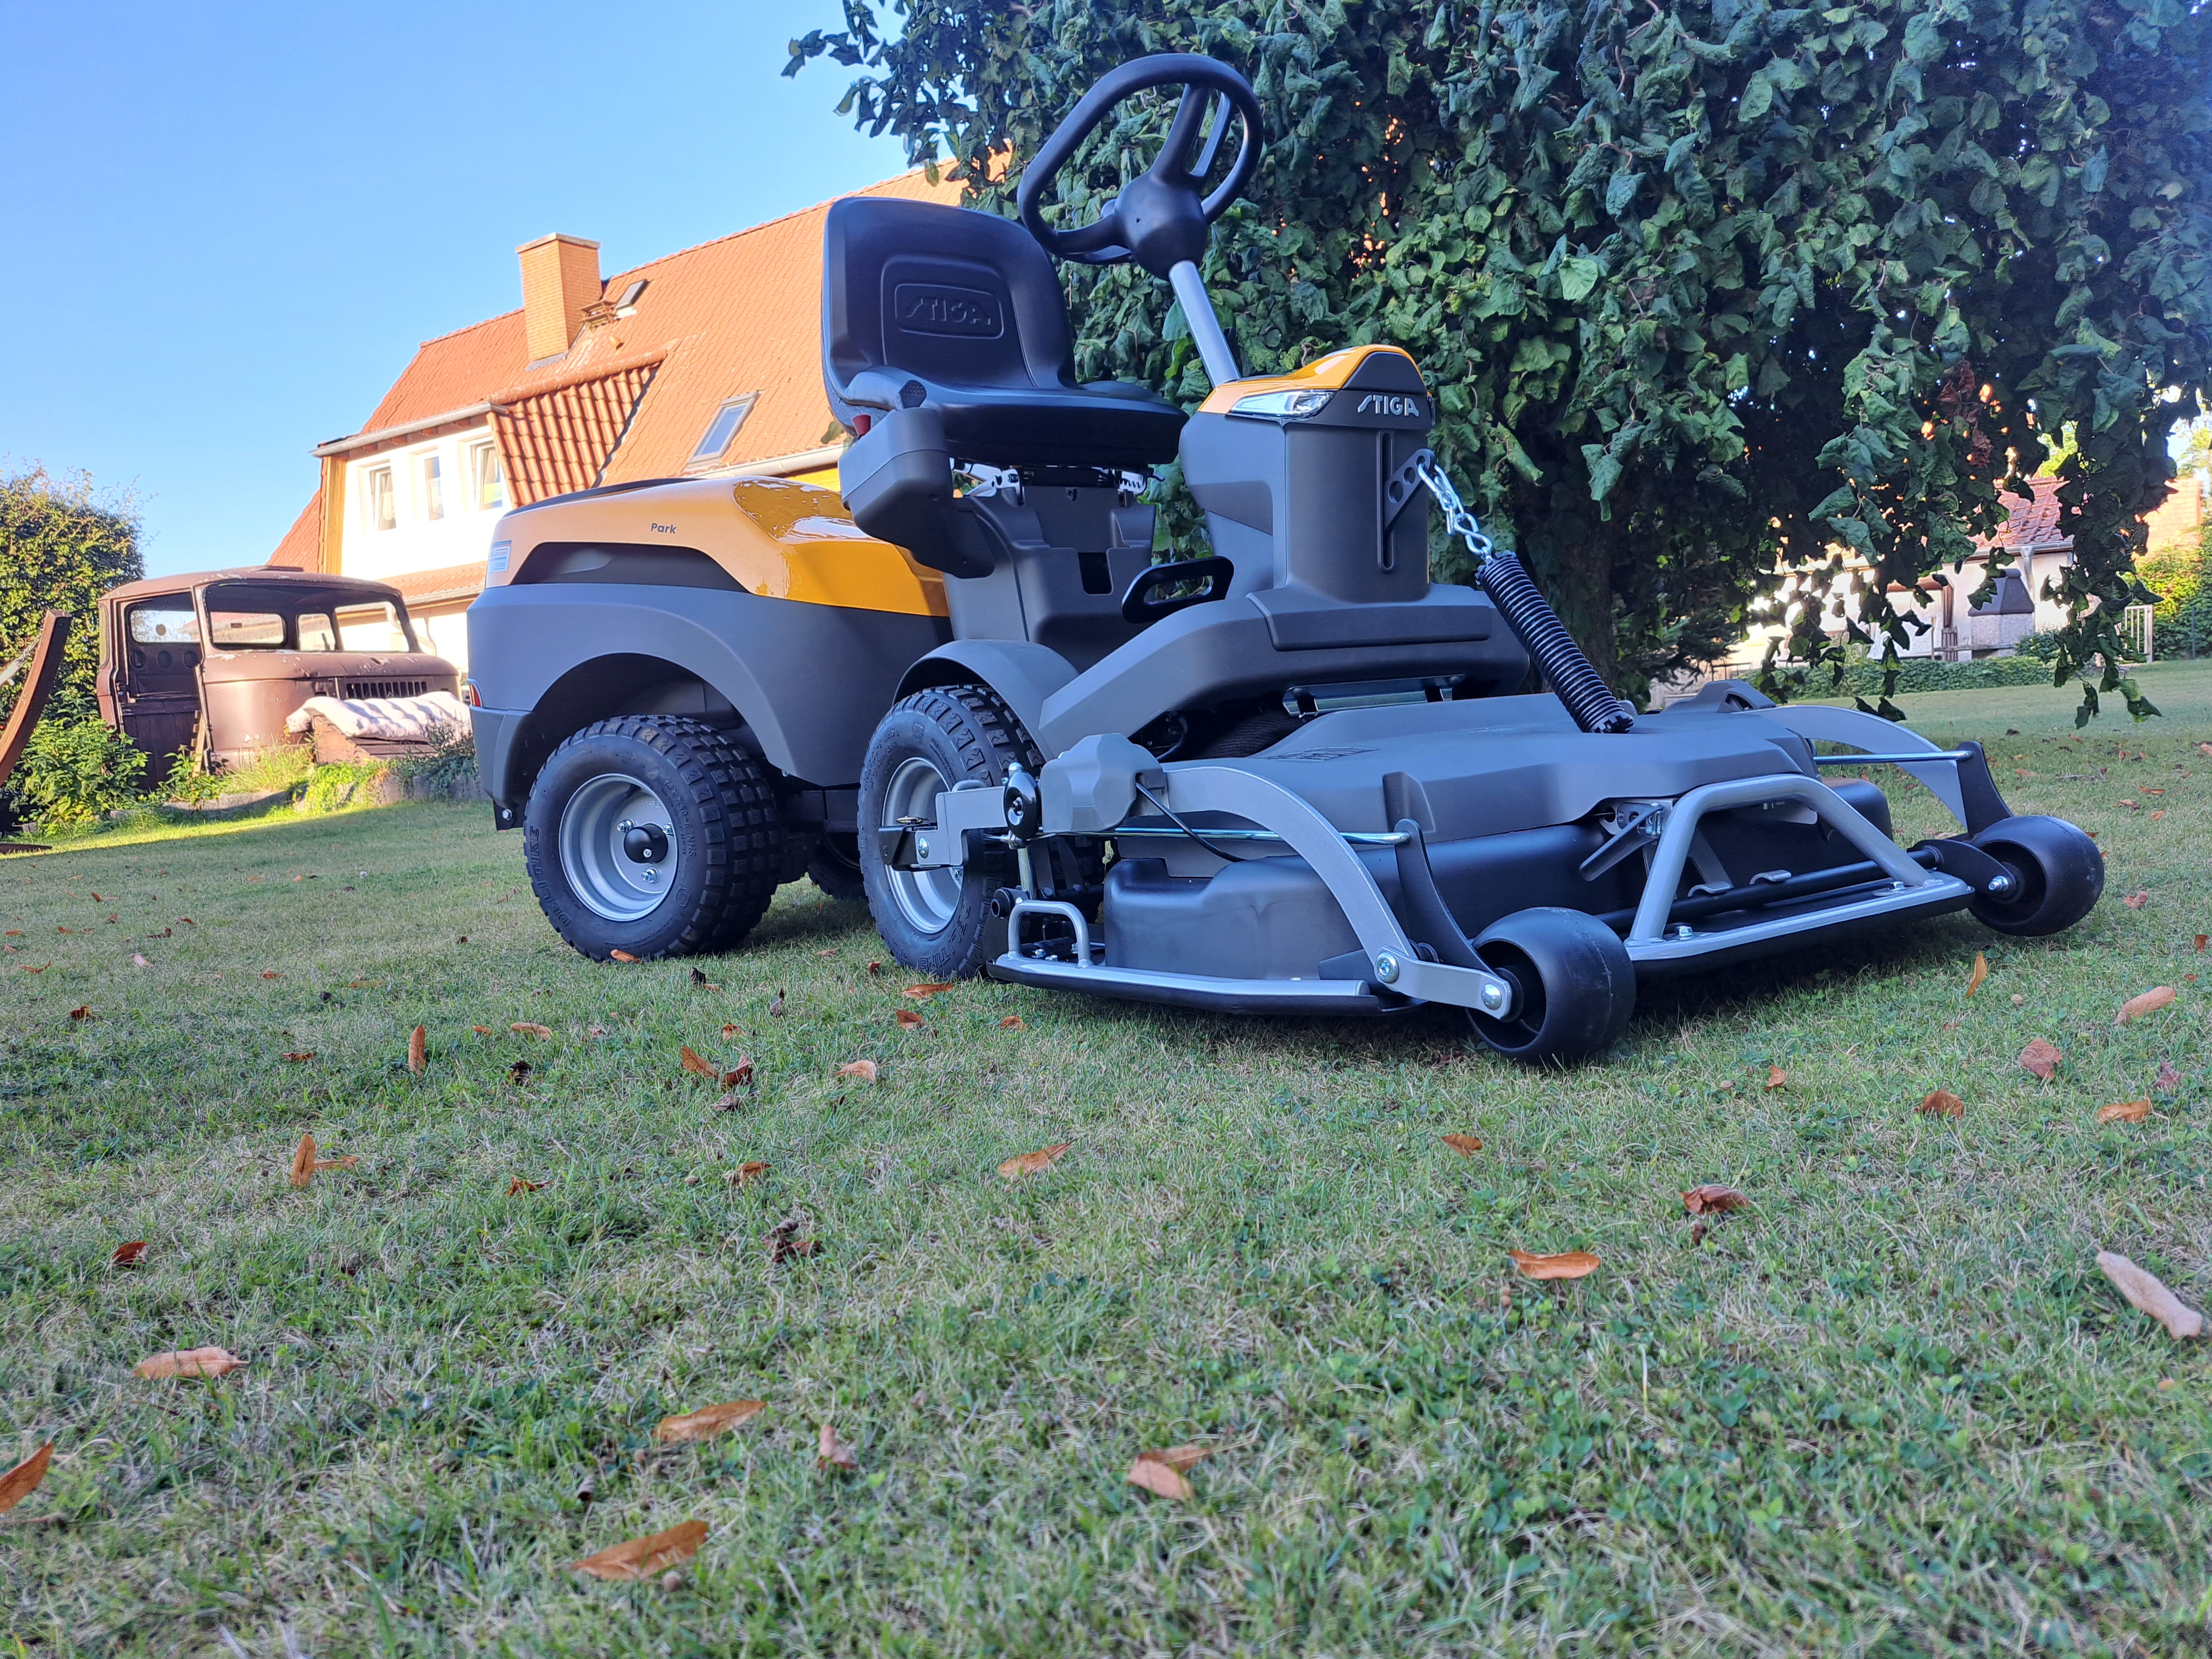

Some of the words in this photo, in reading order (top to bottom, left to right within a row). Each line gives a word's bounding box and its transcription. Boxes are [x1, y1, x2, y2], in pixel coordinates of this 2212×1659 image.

[906, 296, 991, 325] STIGA
[1357, 394, 1419, 417] STIGA
[651, 522, 677, 534] Park
[530, 825, 543, 876] TIRE
[686, 834, 697, 857] NHS
[537, 880, 573, 928] DELI
[919, 947, 951, 972] TIRE
